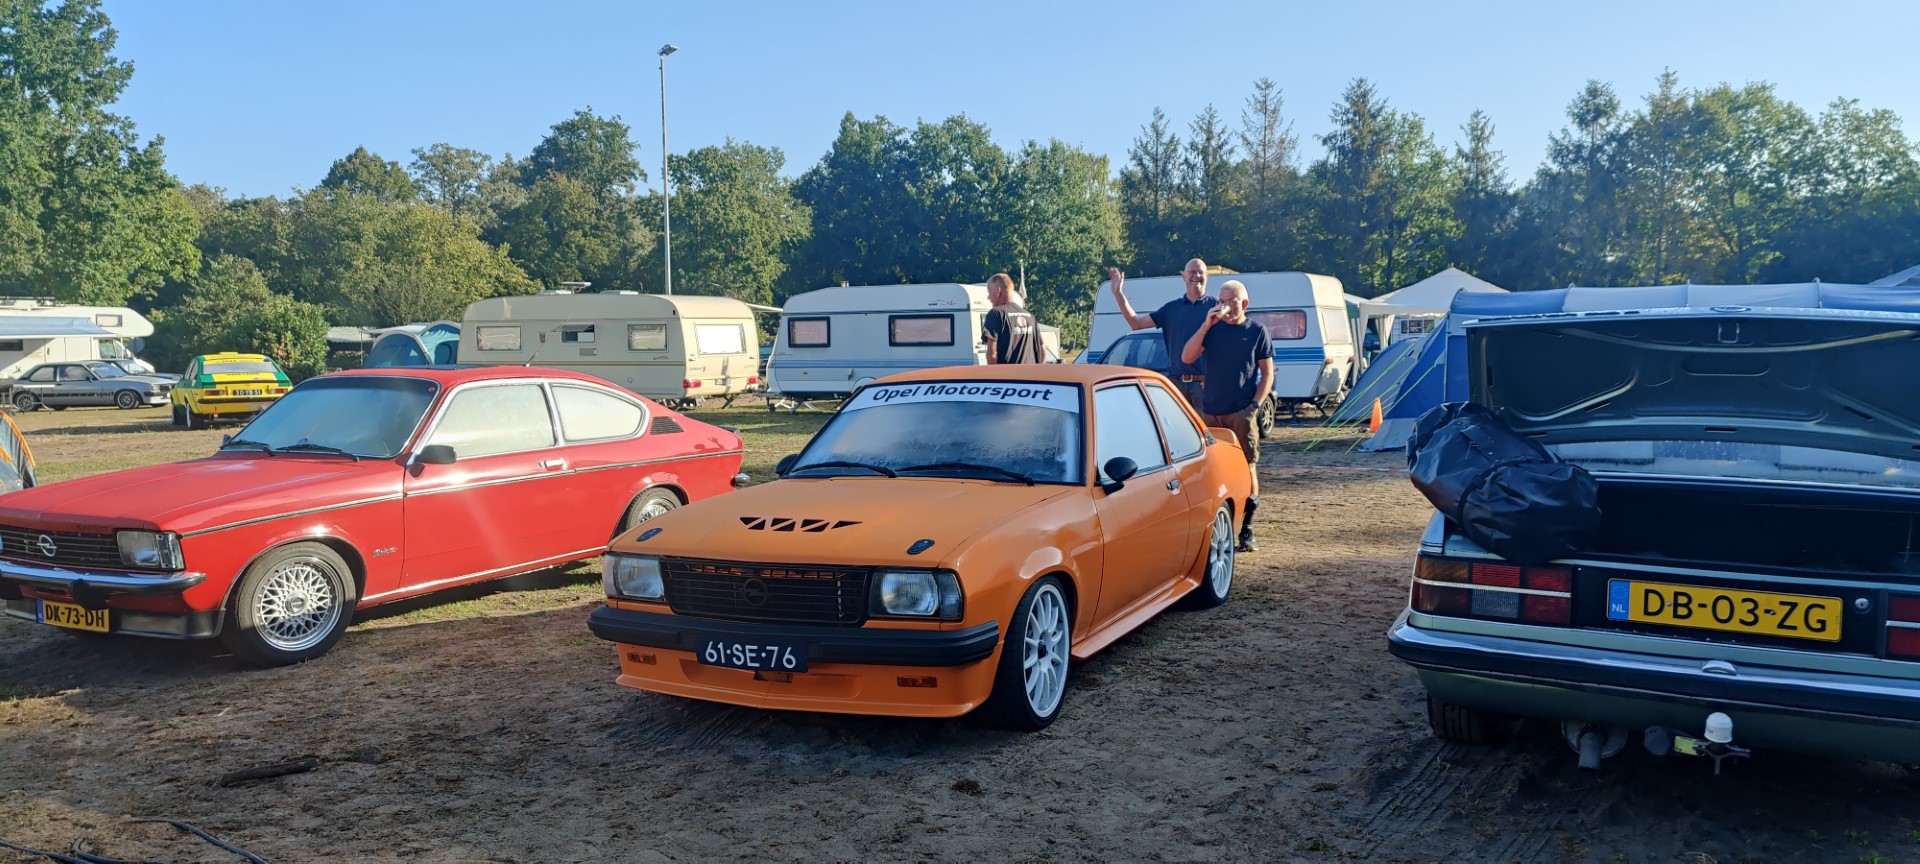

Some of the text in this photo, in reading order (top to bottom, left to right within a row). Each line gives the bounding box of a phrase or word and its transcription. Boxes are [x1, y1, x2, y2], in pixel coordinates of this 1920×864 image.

[872, 385, 1053, 402] Opel Motorsport
[45, 604, 105, 628] DK-73-DH
[1611, 603, 1626, 613] NL
[1642, 588, 1827, 633] DB-03-ZG
